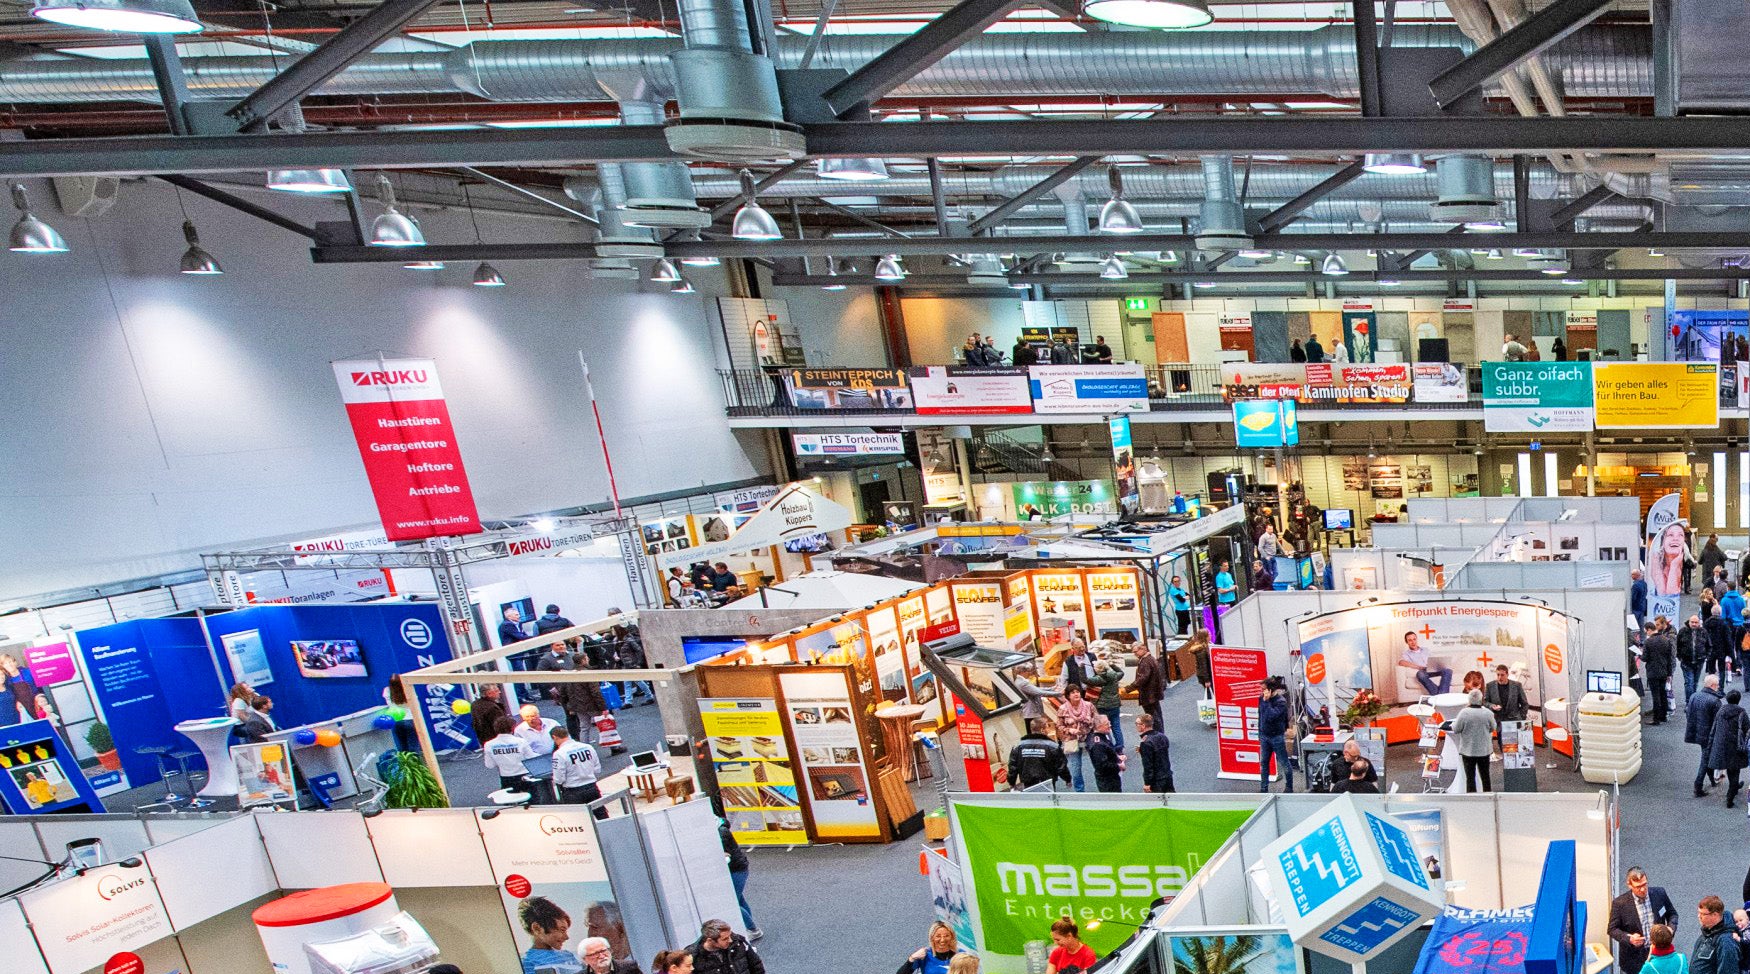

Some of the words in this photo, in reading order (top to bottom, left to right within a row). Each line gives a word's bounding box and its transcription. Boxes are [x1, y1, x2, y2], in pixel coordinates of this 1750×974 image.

[371, 370, 428, 385] RUKU
[805, 370, 893, 380] STEINTEPPICH
[1495, 367, 1533, 381] Ganz
[1538, 365, 1582, 381] oifach
[1304, 384, 1367, 399] Kaminofen
[1371, 384, 1410, 399] Studio
[1496, 382, 1541, 396] subbr.
[1597, 380, 1613, 389] Wir
[1616, 380, 1644, 391] geben
[1647, 380, 1668, 389] alles
[1597, 391, 1611, 400] für
[1613, 391, 1637, 400] Ihren
[1639, 391, 1660, 400] Bau.
[378, 416, 441, 428] Haustüren
[370, 439, 447, 452] Garagentore
[820, 435, 842, 444] HTS
[844, 434, 898, 445] Tortechnik
[407, 462, 454, 473] Hoftore
[409, 484, 461, 496] Antriebe
[781, 503, 808, 515] Holzbau
[397, 515, 470, 528] www.ruku.info
[785, 513, 813, 525] Küppers
[520, 536, 550, 554] RUKU
[551, 533, 593, 548] TORE-TÜREN
[1392, 607, 1448, 618] Treffpunkt
[1450, 606, 1519, 618] Energiesparer
[493, 746, 521, 755] DELUXE
[569, 750, 593, 765] PUR
[1329, 818, 1360, 879] KENNGOTT
[110, 877, 145, 896] SOLVIS
[1281, 851, 1311, 914] TREPPEN
[1372, 899, 1418, 922] KENNGOTT
[66, 929, 90, 943] Solvis
[90, 903, 154, 932] Solar-Kollektoren
[1323, 931, 1370, 954] TREPPEN
